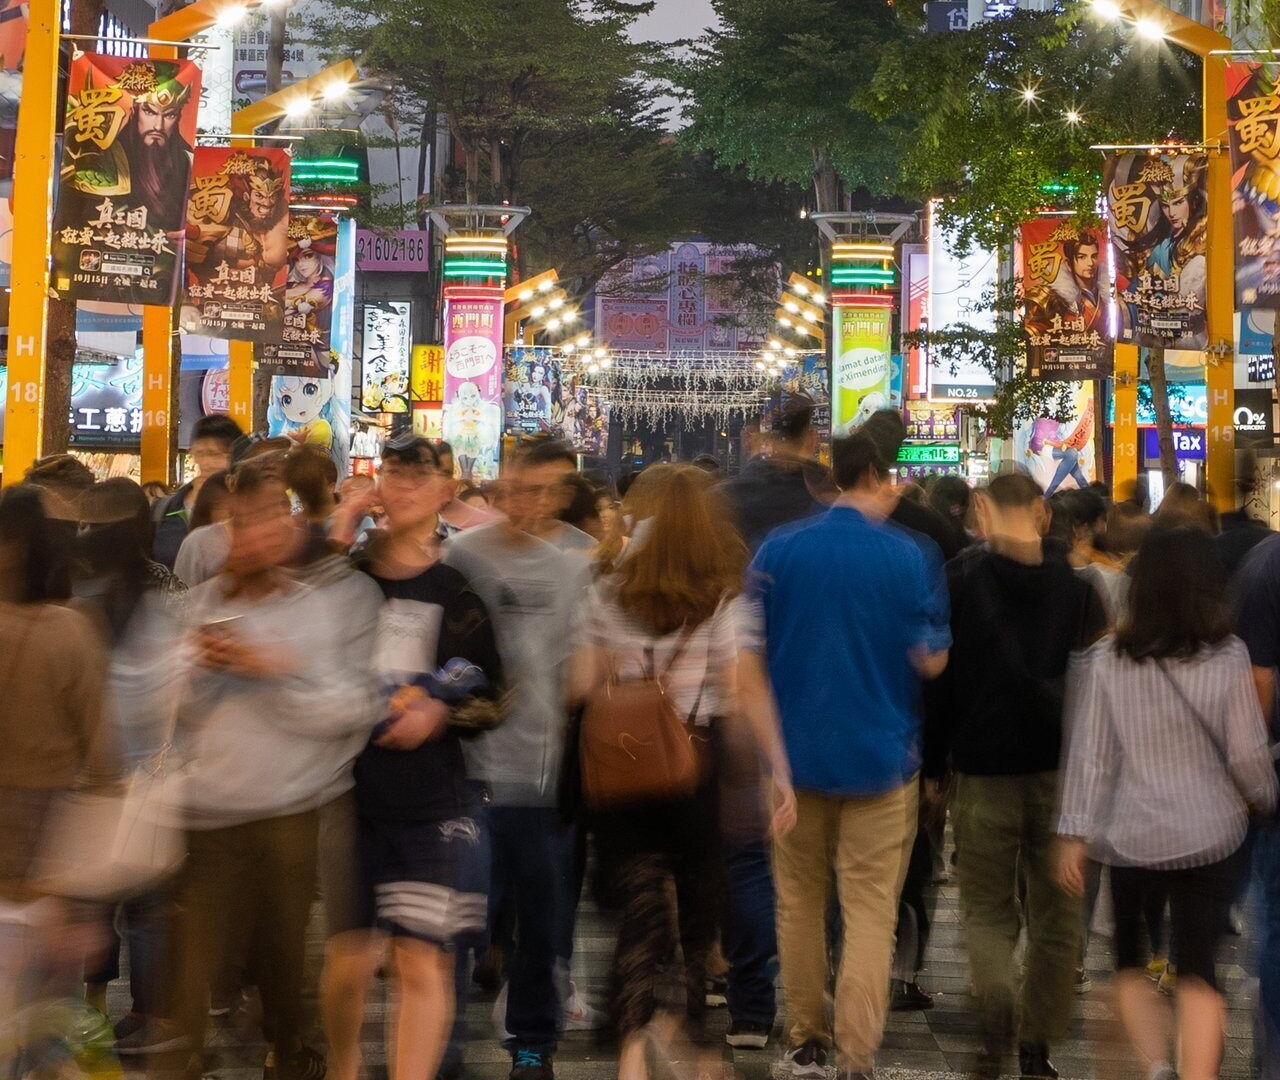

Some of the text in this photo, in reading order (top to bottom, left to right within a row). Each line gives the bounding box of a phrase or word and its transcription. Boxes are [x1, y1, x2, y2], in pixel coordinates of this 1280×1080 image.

[73, 89, 125, 151] 蜀
[191, 176, 233, 224] 蜀
[1111, 183, 1151, 233] 蜀
[88, 198, 148, 231] 真三國
[1027, 241, 1062, 284] 蜀
[73, 273, 108, 285] 10月15日
[208, 261, 256, 285] 真三國
[451, 311, 494, 329] 西門町
[1046, 313, 1086, 334] 真三國
[17, 336, 35, 356] H
[149, 374, 163, 390] H
[10, 382, 38, 403] 18
[947, 388, 978, 397] NO.26
[1214, 389, 1228, 406] H
[145, 410, 166, 426] 16
[235, 402, 247, 416] H
[1120, 413, 1132, 426] H
[1172, 432, 1201, 451] Tax
[1211, 426, 1233, 442] 15
[1117, 443, 1135, 457] 13
